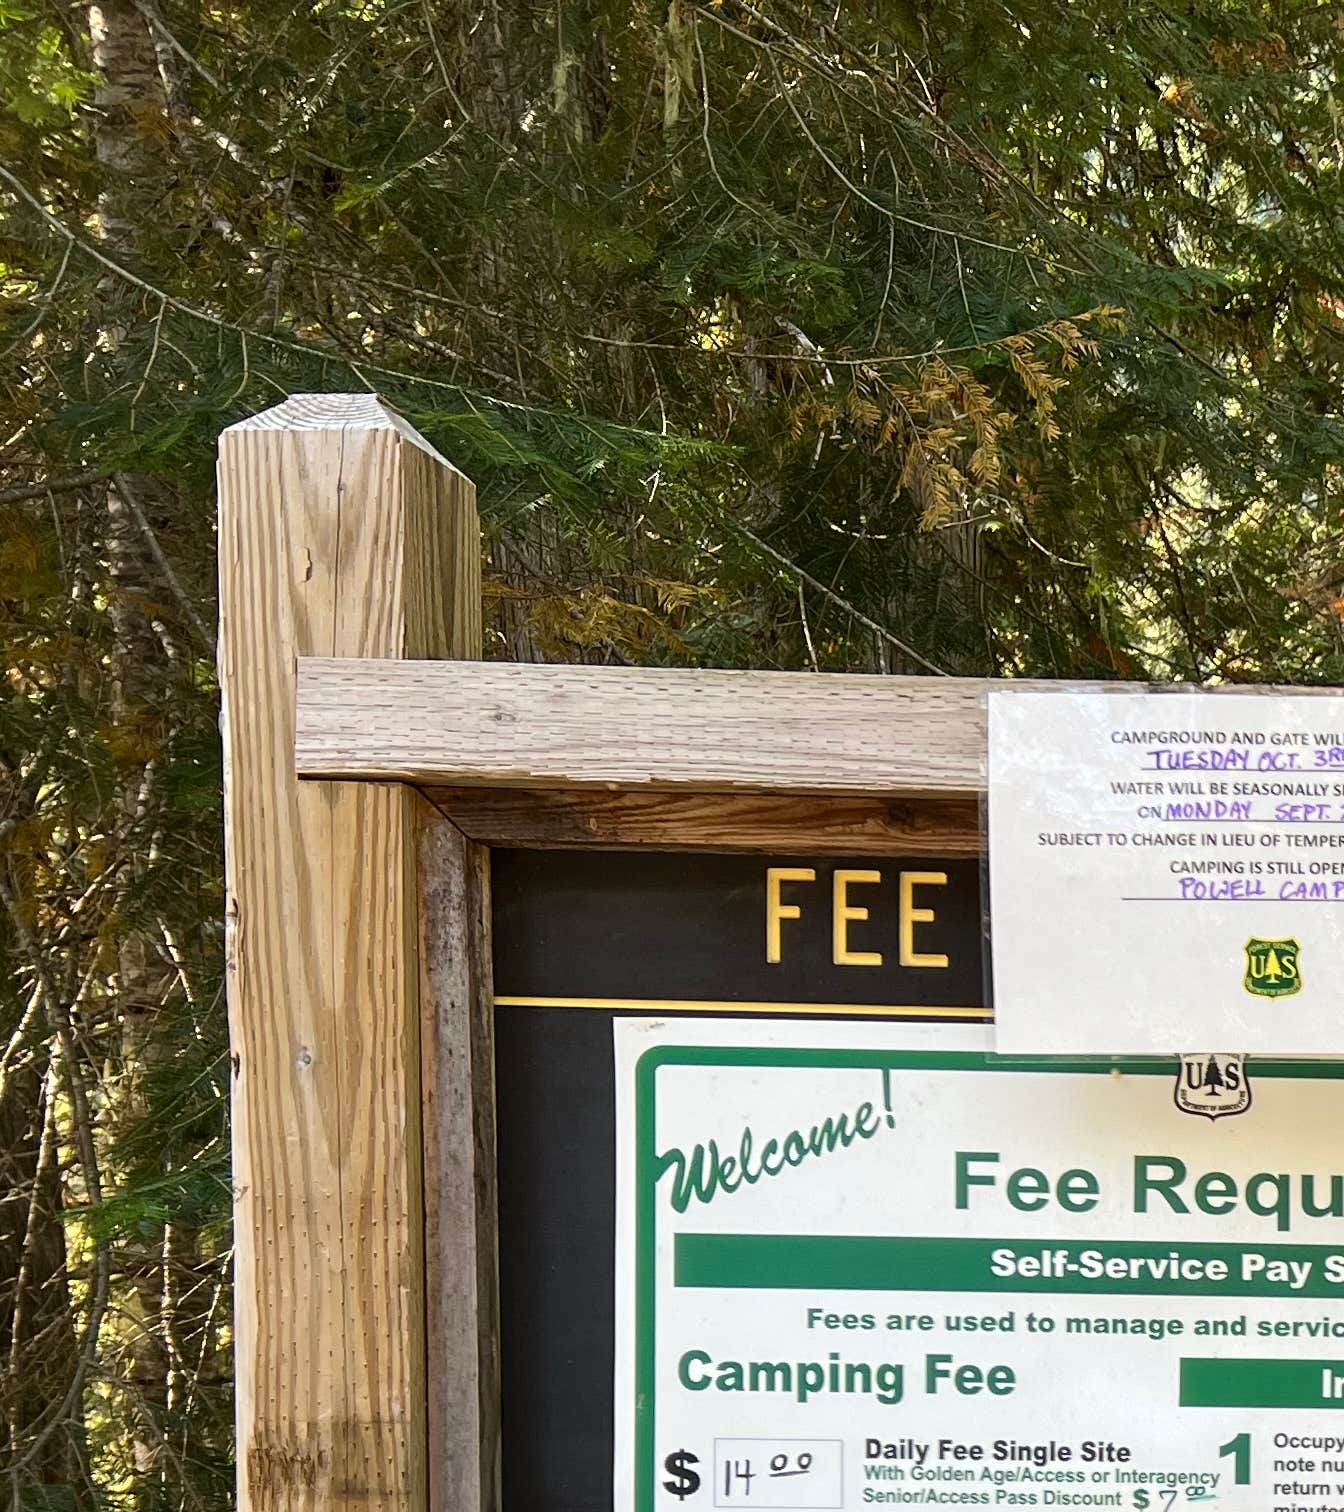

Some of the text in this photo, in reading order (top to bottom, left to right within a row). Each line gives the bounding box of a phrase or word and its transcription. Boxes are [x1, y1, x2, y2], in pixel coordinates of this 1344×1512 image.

[1111, 731, 1227, 745] CAMPGROUND
[1231, 731, 1266, 745] AND
[1270, 732, 1310, 746] GATE
[1147, 748, 1253, 771] TUESDAY
[1110, 782, 1164, 795] WATER
[1168, 782, 1205, 795] WILL
[1209, 782, 1229, 796] BE
[1232, 782, 1330, 797] SEASONALLY
[1038, 832, 1103, 846] SUBJECT
[1106, 833, 1128, 846] TO
[1131, 833, 1197, 847] CHANGE
[1201, 833, 1218, 847] IN
[1222, 833, 1255, 847] LIEU
[1259, 834, 1281, 847] OF
[1178, 877, 1266, 900] POWELL
[767, 868, 948, 967] FEE
[956, 1152, 1099, 1212] Fee
[990, 1248, 1229, 1281] Self-Service
[1241, 1253, 1313, 1289] Pay
[807, 1307, 876, 1330] Fees
[886, 1314, 935, 1331] are
[945, 1311, 1015, 1333] used
[1025, 1312, 1056, 1333] to
[1065, 1317, 1185, 1341] manage
[1193, 1315, 1247, 1337] and
[678, 1349, 1017, 1405] Camping Fee
[864, 1438, 1132, 1467] Daily Fee Single Site
